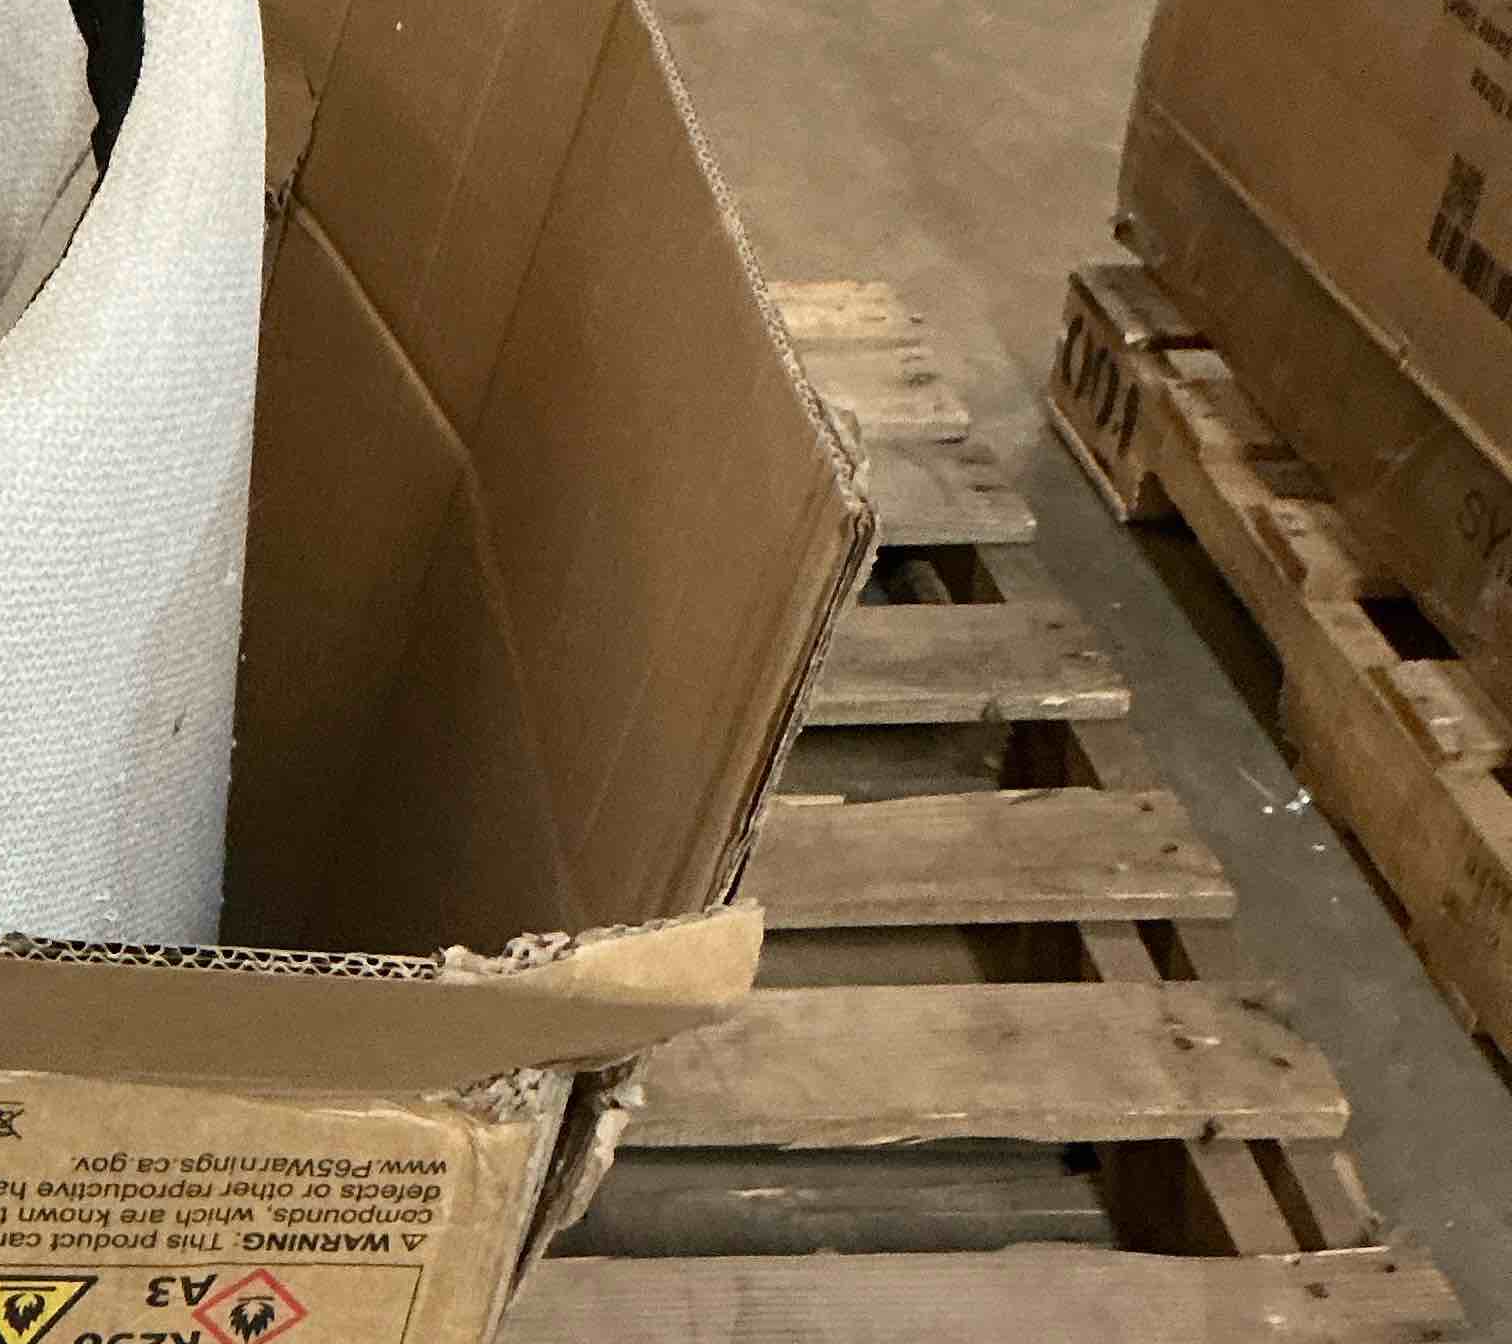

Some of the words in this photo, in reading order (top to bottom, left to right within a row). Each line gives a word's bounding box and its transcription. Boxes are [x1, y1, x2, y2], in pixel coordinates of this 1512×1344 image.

[37, 1178, 212, 1202] reproductive
[219, 1181, 294, 1202] other
[301, 1183, 331, 1200] or
[340, 1183, 441, 1203] defects
[18, 1206, 112, 1227] known
[119, 1208, 166, 1225] are
[175, 1207, 255, 1227] which
[266, 1205, 433, 1227] compounds,
[49, 1228, 159, 1252] product
[167, 1232, 223, 1252] This
[232, 1231, 391, 1252] WARNING:
[144, 1272, 217, 1308] A3
